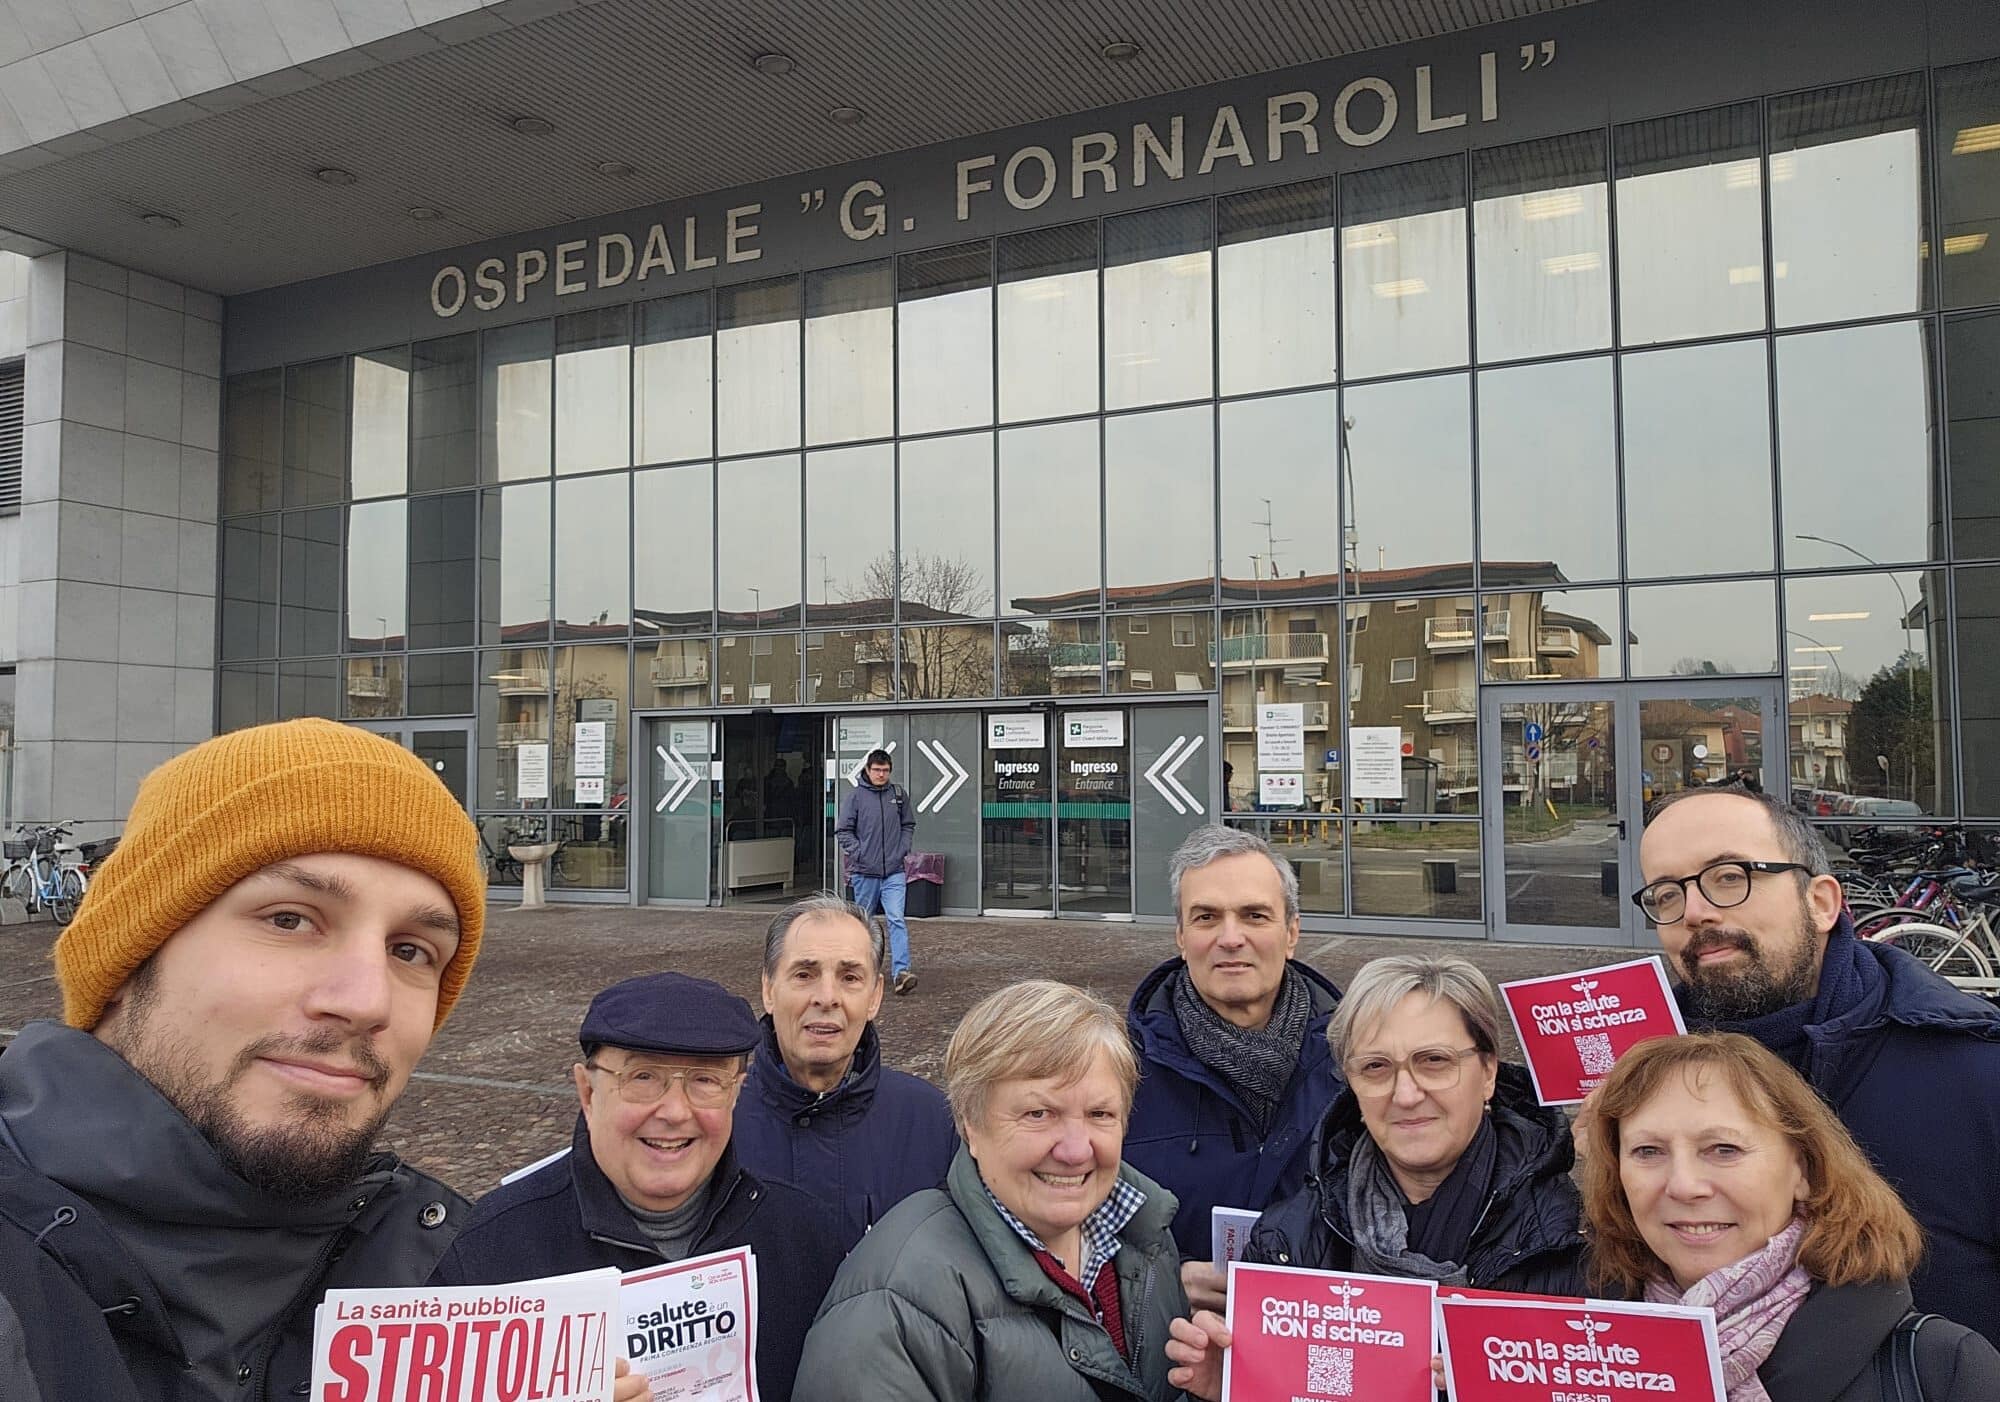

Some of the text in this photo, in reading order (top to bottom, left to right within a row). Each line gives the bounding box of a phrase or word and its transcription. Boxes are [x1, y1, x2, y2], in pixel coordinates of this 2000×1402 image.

[430, 202, 764, 318] OSPEDALE
[994, 760, 1040, 776] Ingresso
[1070, 760, 1118, 776] Ingresso
[998, 778, 1036, 790] Entrance
[1075, 778, 1114, 790] Entrance
[1531, 994, 1620, 1021] Con la salute
[1536, 1007, 1647, 1036] NON si scherza
[336, 1295, 546, 1322] La sanità pubblica
[637, 1300, 707, 1330] salute
[716, 1301, 729, 1310] un
[1261, 1296, 1382, 1325] Con la salute
[627, 1310, 736, 1359] DIRITTO
[1262, 1315, 1405, 1348] NON si scherza
[323, 1311, 607, 1402] STRITOLATA
[640, 1352, 660, 1363] PRIMA
[1483, 1336, 1640, 1366] Con la salute
[1487, 1358, 1677, 1393] NON si scherza
